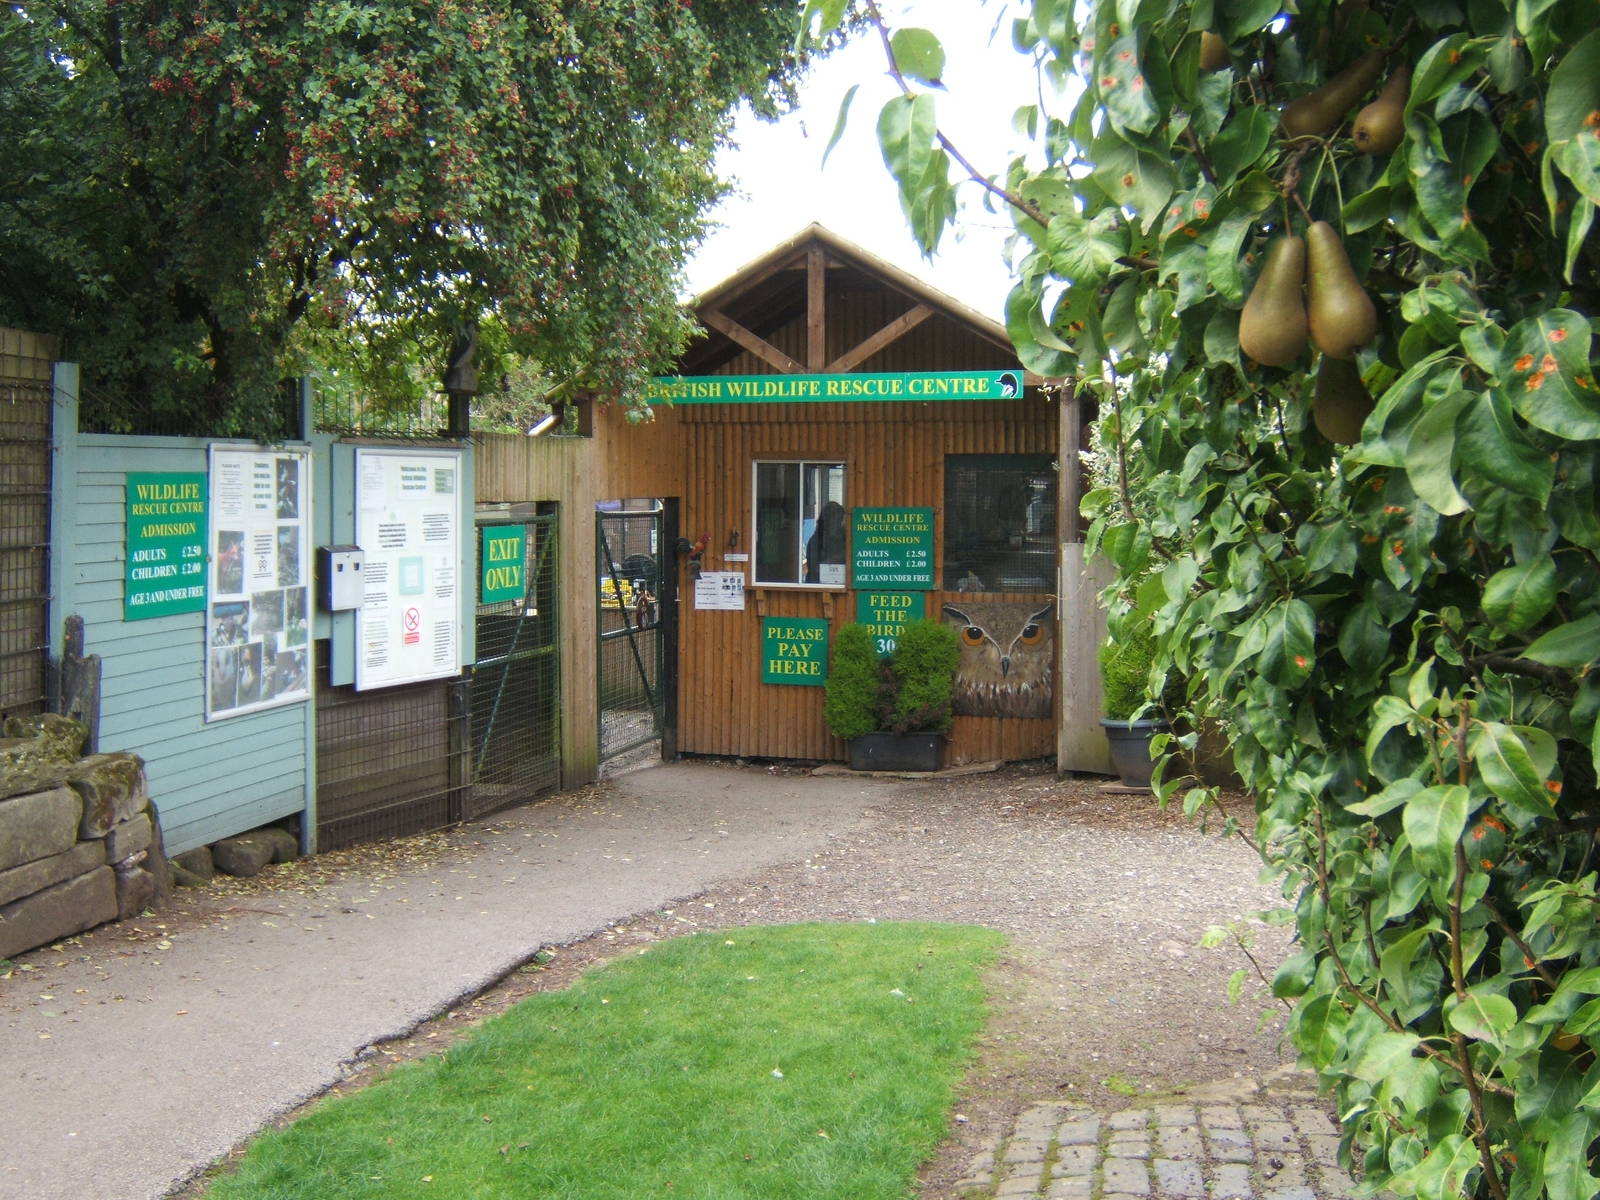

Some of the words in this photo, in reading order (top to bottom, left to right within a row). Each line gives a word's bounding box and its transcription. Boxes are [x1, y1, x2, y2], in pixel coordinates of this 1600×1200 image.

[647, 382, 721, 398] BRITISH
[727, 381, 820, 397] WILDLIFE
[826, 380, 903, 396] RESCUE
[908, 377, 990, 394] CENTRE
[136, 483, 200, 500] WILDLIFE
[132, 503, 168, 516] RESCUE
[169, 501, 204, 513] CENTRE
[862, 513, 924, 523] WILDLIFE
[140, 522, 196, 538] ADMISSION
[865, 536, 920, 544] ADMISSION
[132, 548, 167, 562] ADULTS
[488, 537, 520, 561] EXIT
[856, 550, 889, 558] ADULTS
[856, 560, 901, 568] CHILDREN
[131, 564, 178, 580] CHILDREN
[486, 565, 521, 591] ONLY
[856, 574, 870, 582] AGE
[875, 574, 889, 582] AND
[889, 574, 912, 582] UNDER
[913, 574, 930, 582] FREE
[130, 592, 145, 606] AGE
[149, 590, 164, 603] AND
[164, 587, 187, 601] UNDER
[187, 585, 204, 598] FREE
[869, 595, 913, 608] FEED
[873, 610, 907, 622] THE
[768, 627, 824, 640] PLEASE
[866, 624, 906, 637] BIRD
[777, 642, 813, 658] PAY
[769, 660, 821, 676] HERE
